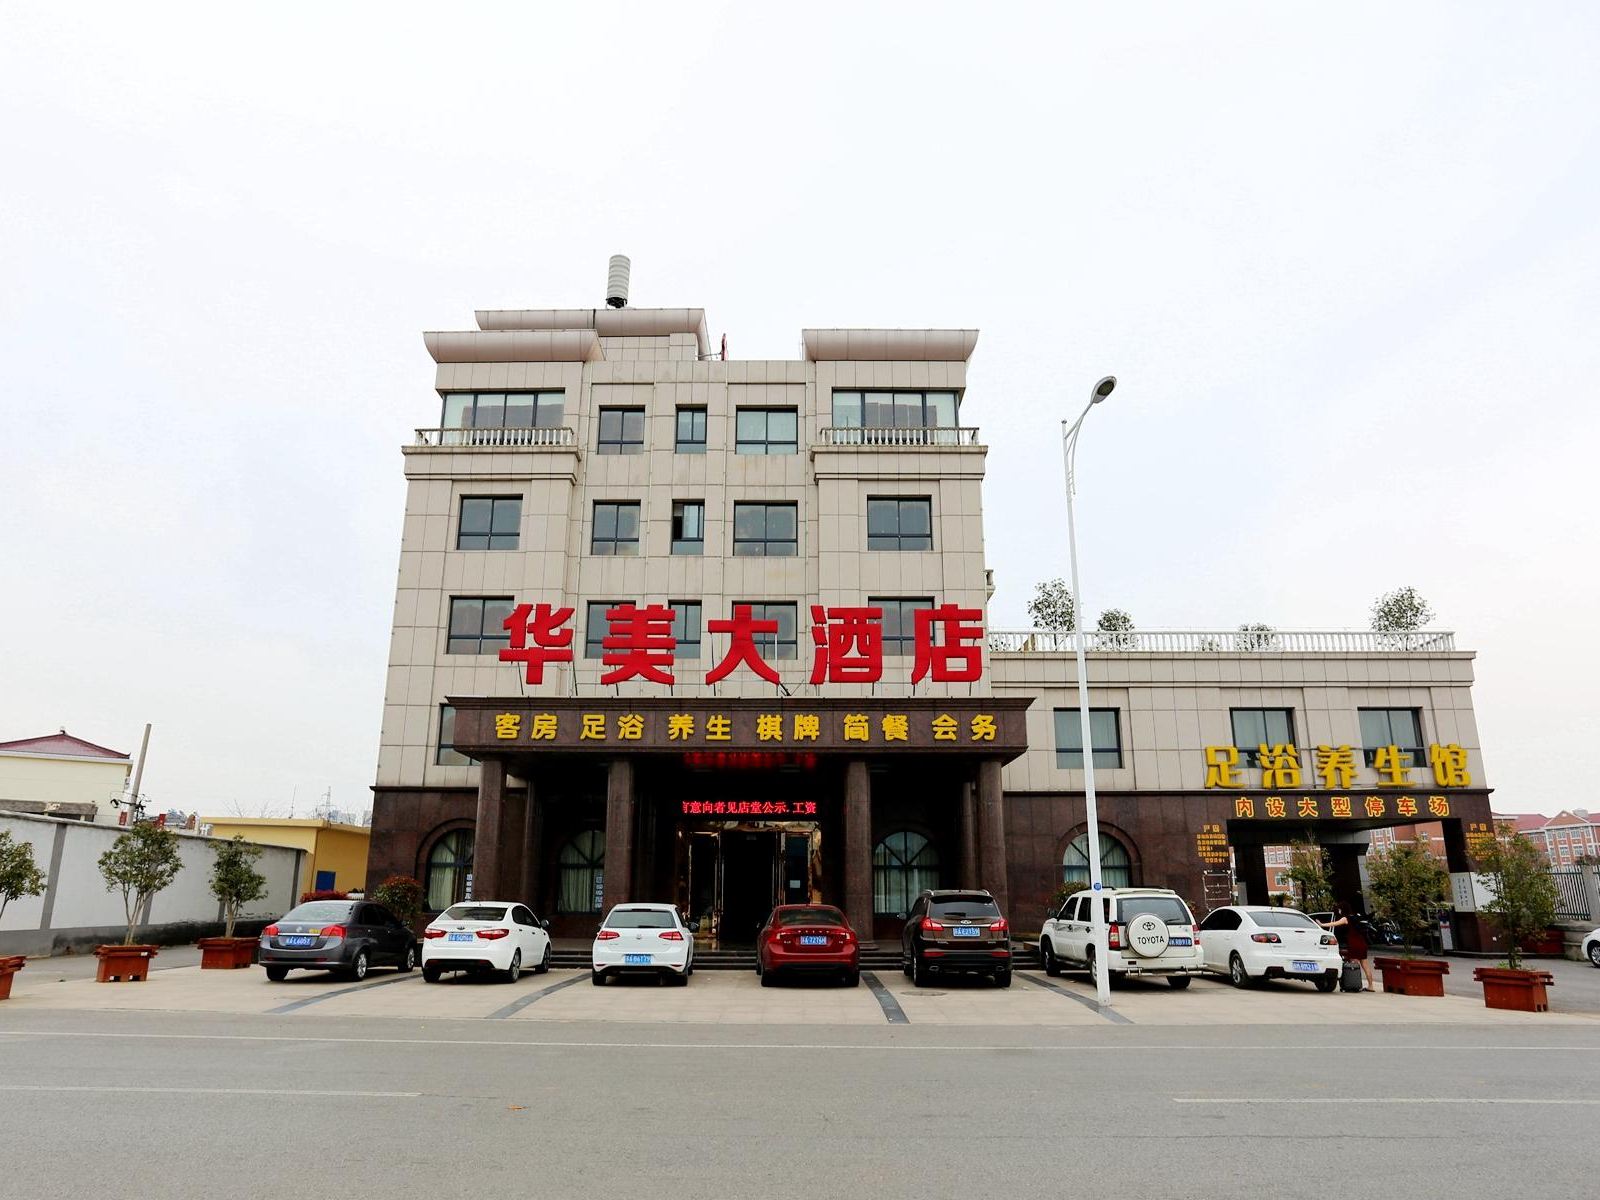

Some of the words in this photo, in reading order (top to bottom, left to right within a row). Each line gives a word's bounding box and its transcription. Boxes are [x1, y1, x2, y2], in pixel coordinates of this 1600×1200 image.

[498, 603, 984, 686] 华美大酒店
[495, 713, 558, 740] 客房
[580, 713, 645, 740] 足浴
[668, 713, 732, 740] 养生
[756, 713, 821, 741] 棋牌
[844, 713, 909, 741] 简餐
[932, 713, 998, 741] 会务
[1204, 743, 1472, 791] 足浴养生馆
[1235, 795, 1450, 818] 内设大型停车场
[1137, 936, 1165, 945] TOYOTA
